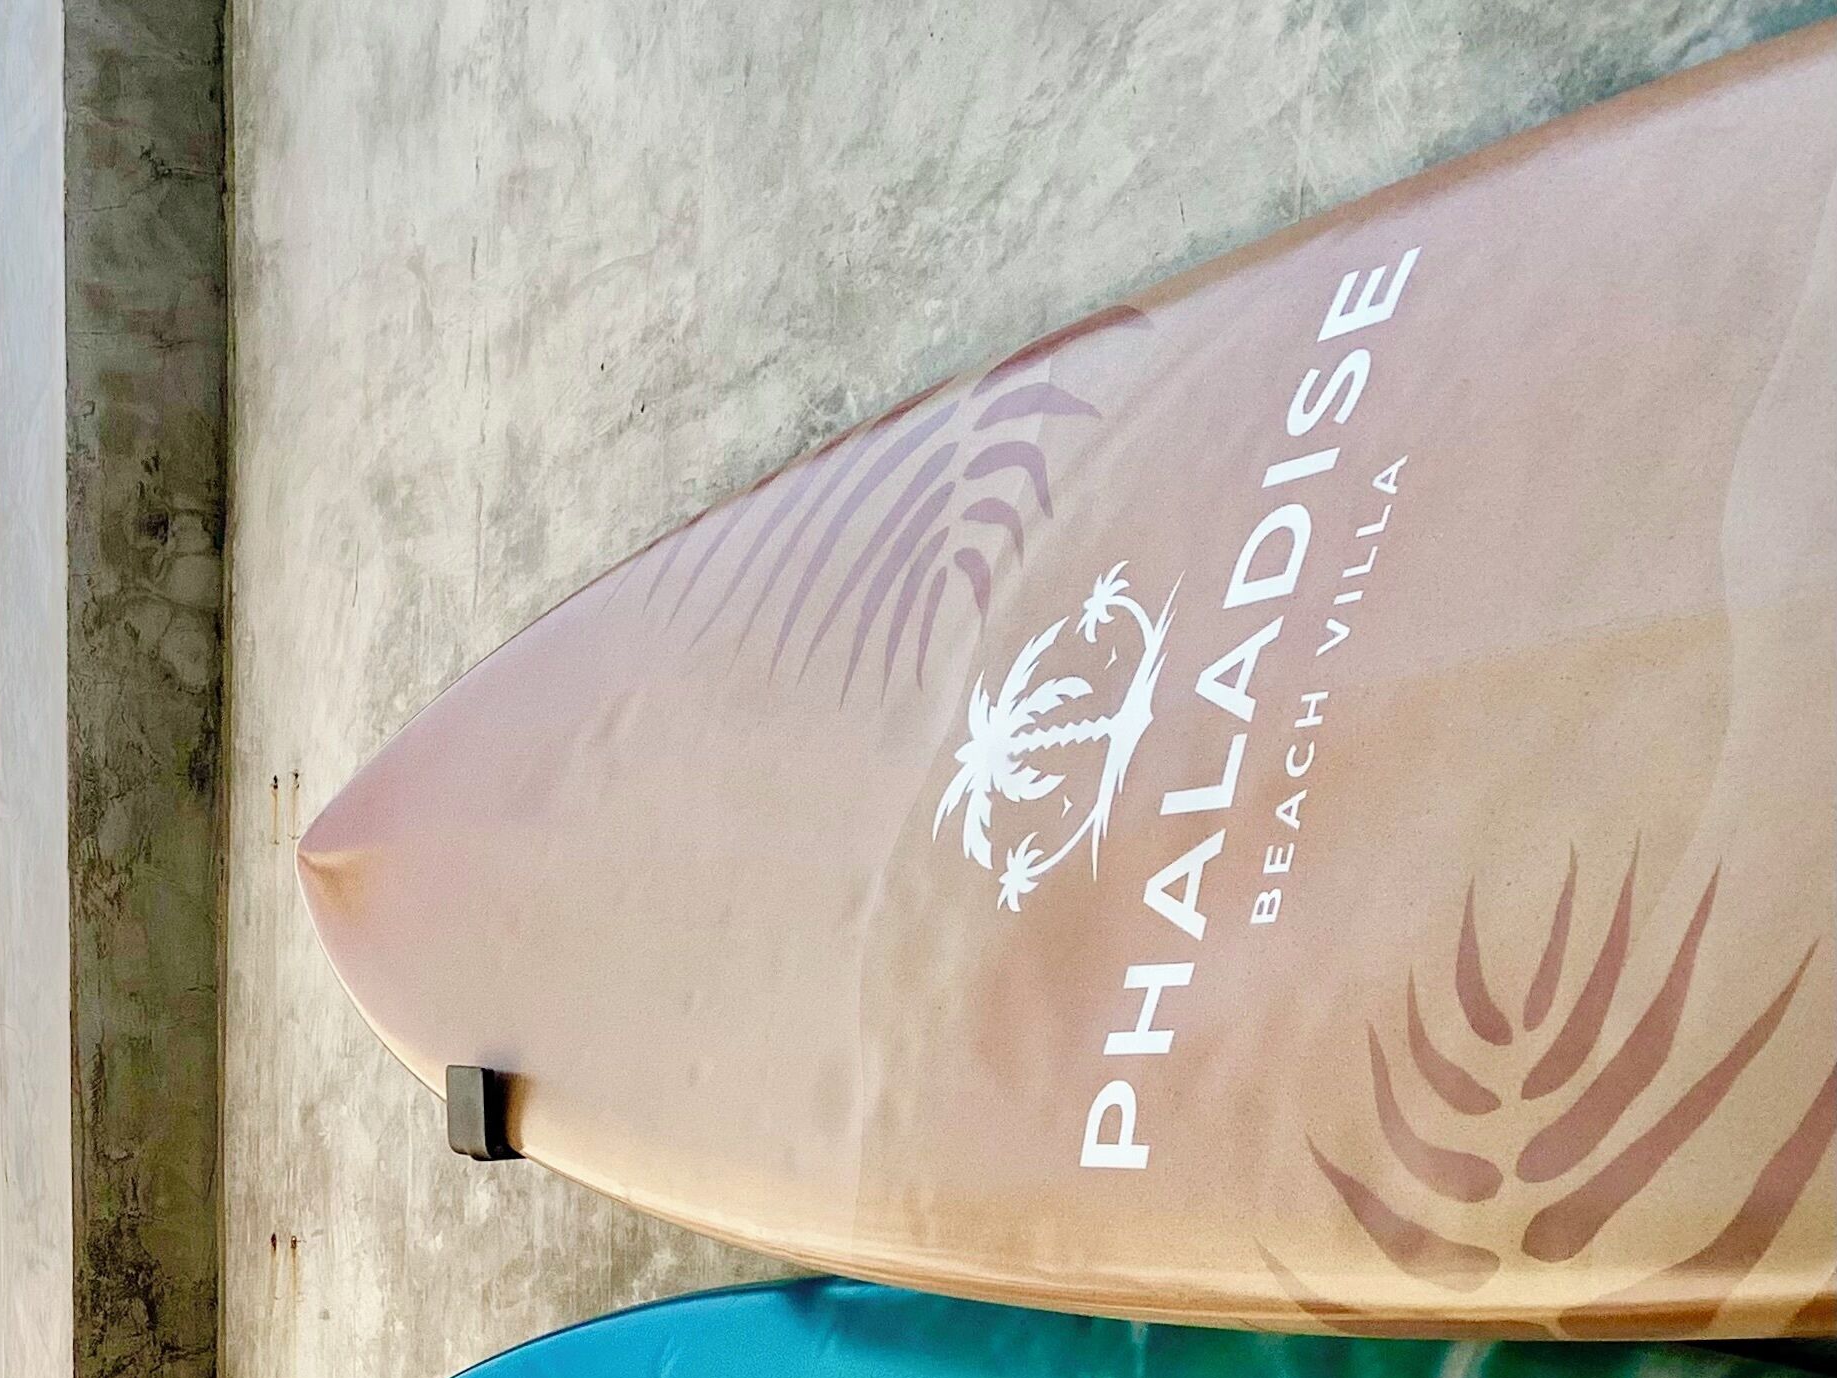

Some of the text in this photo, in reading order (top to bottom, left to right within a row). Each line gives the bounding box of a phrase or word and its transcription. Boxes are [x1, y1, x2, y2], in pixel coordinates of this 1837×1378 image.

[1079, 245, 1422, 1170] PHALADISE
[1250, 455, 1408, 925] BEACH VILLA
